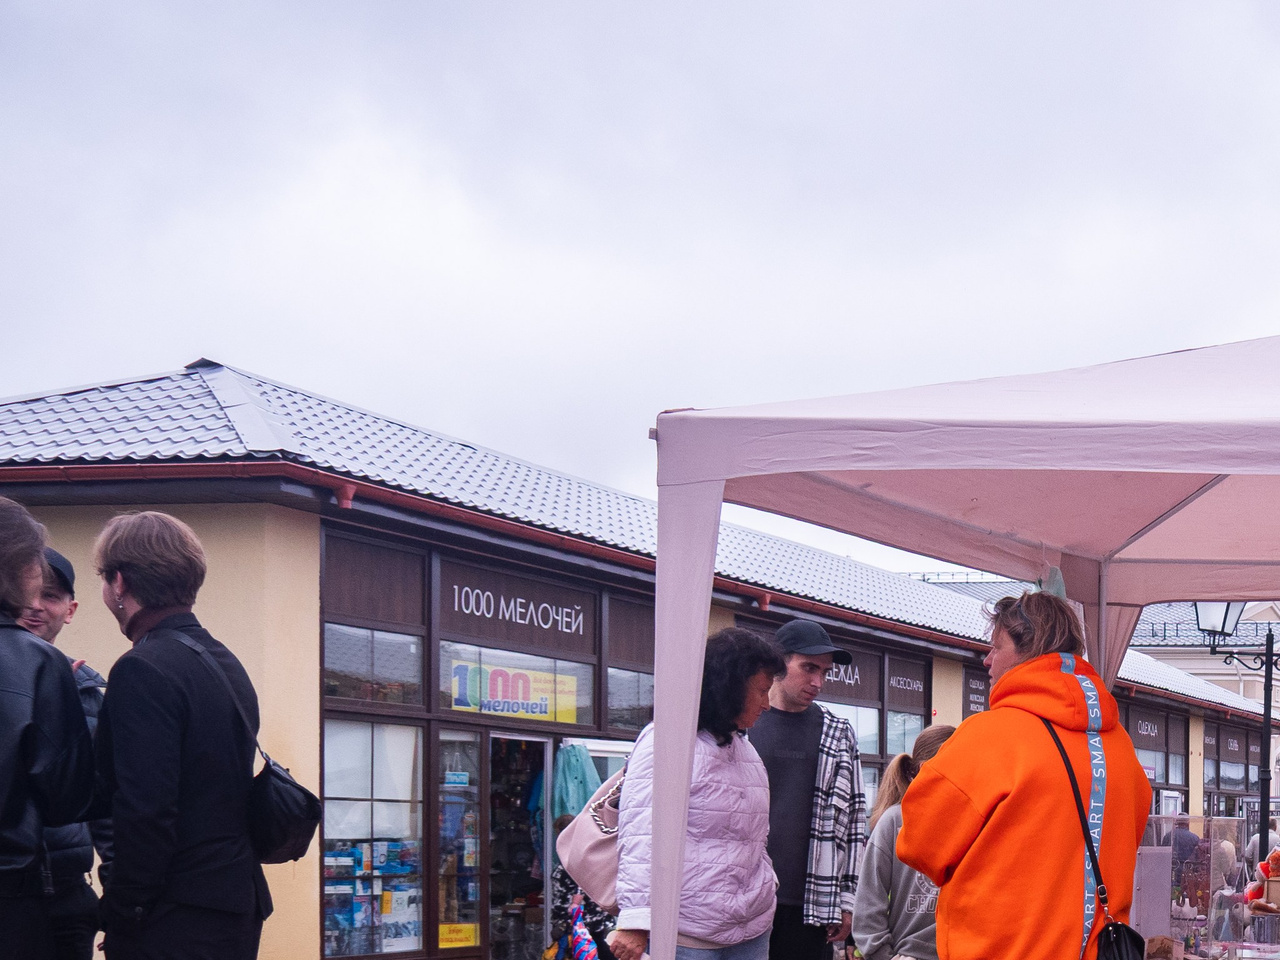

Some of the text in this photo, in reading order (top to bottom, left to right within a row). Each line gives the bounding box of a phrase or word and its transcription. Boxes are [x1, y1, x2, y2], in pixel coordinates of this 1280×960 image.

[453, 585, 584, 635] 1000 МЕЛОЧЕЙ
[824, 662, 860, 686] ДЕЖДА
[889, 676, 923, 692] АКСЕССУАРЫ
[481, 696, 549, 715] мелочей
[1137, 720, 1159, 737] ОДЕЖДА
